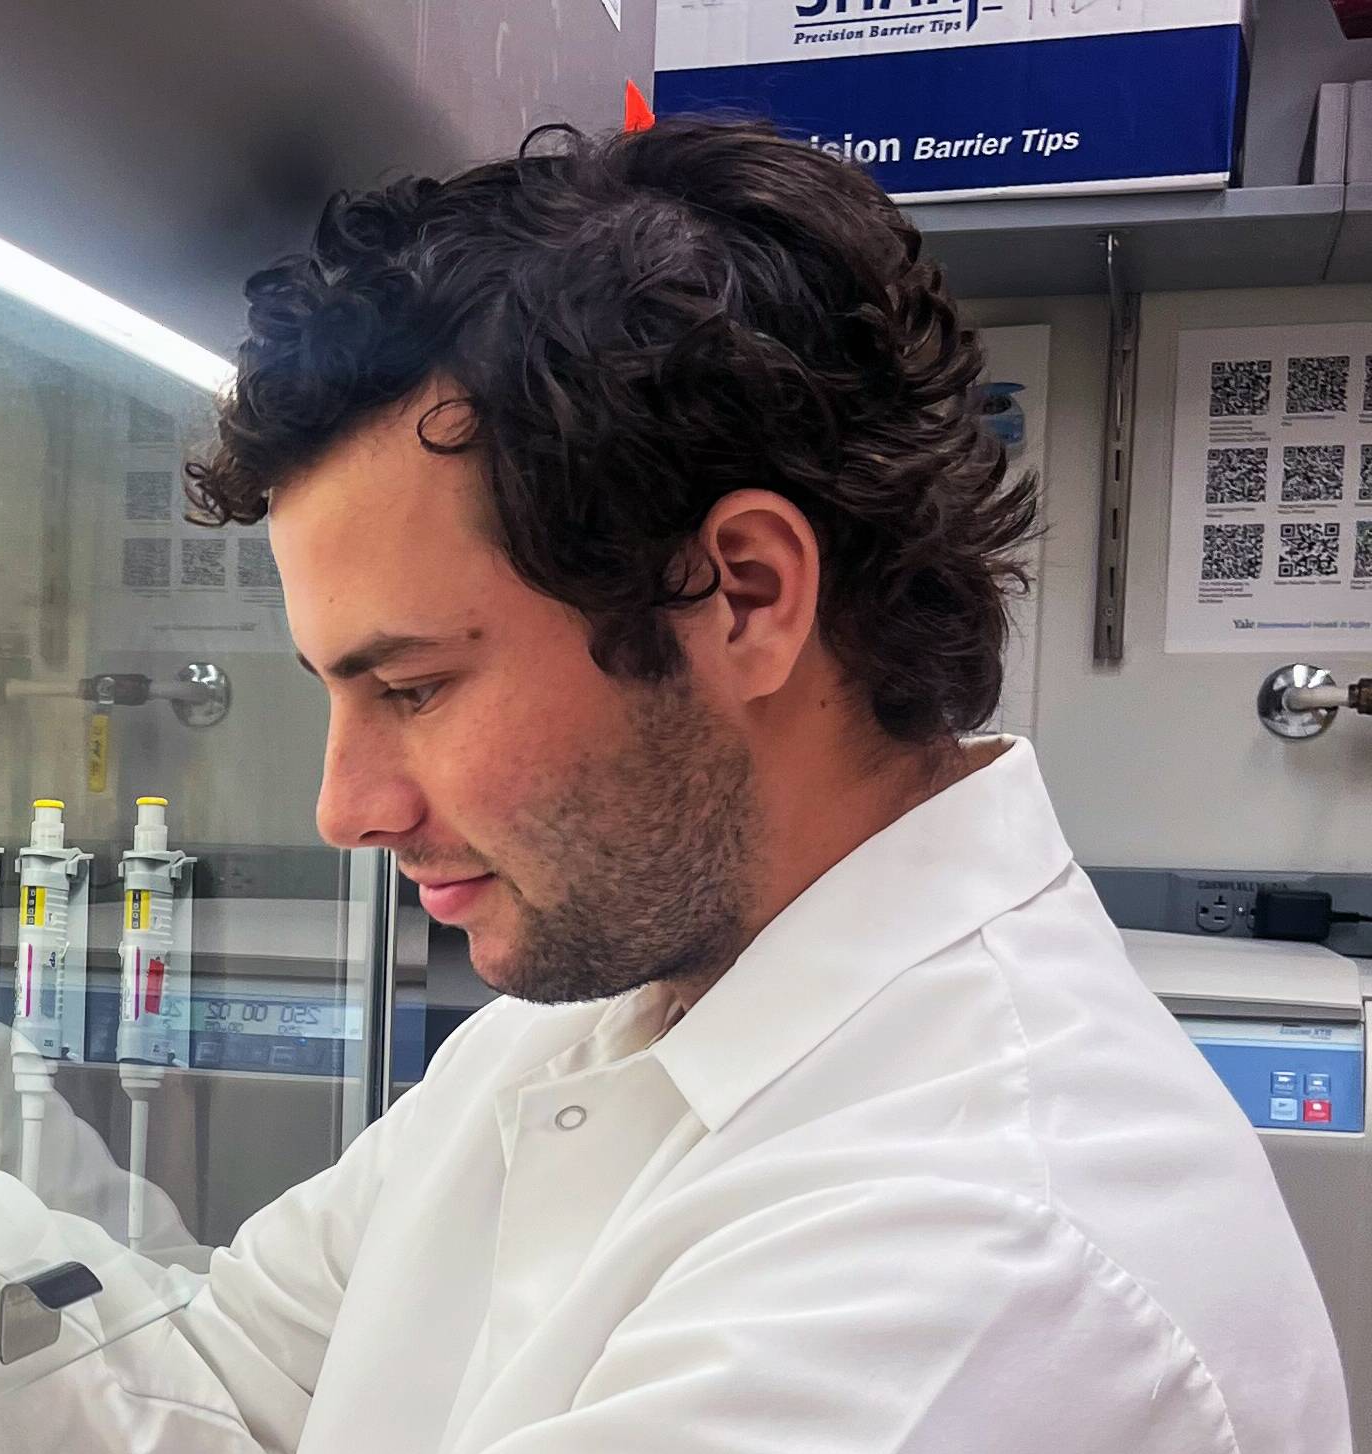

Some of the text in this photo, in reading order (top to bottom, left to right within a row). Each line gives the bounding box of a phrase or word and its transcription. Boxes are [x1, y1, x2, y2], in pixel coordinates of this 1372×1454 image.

[793, 19, 962, 45] Precision Barrier Tips
[913, 133, 1012, 161] Barrier
[1021, 128, 1080, 156] Tips
